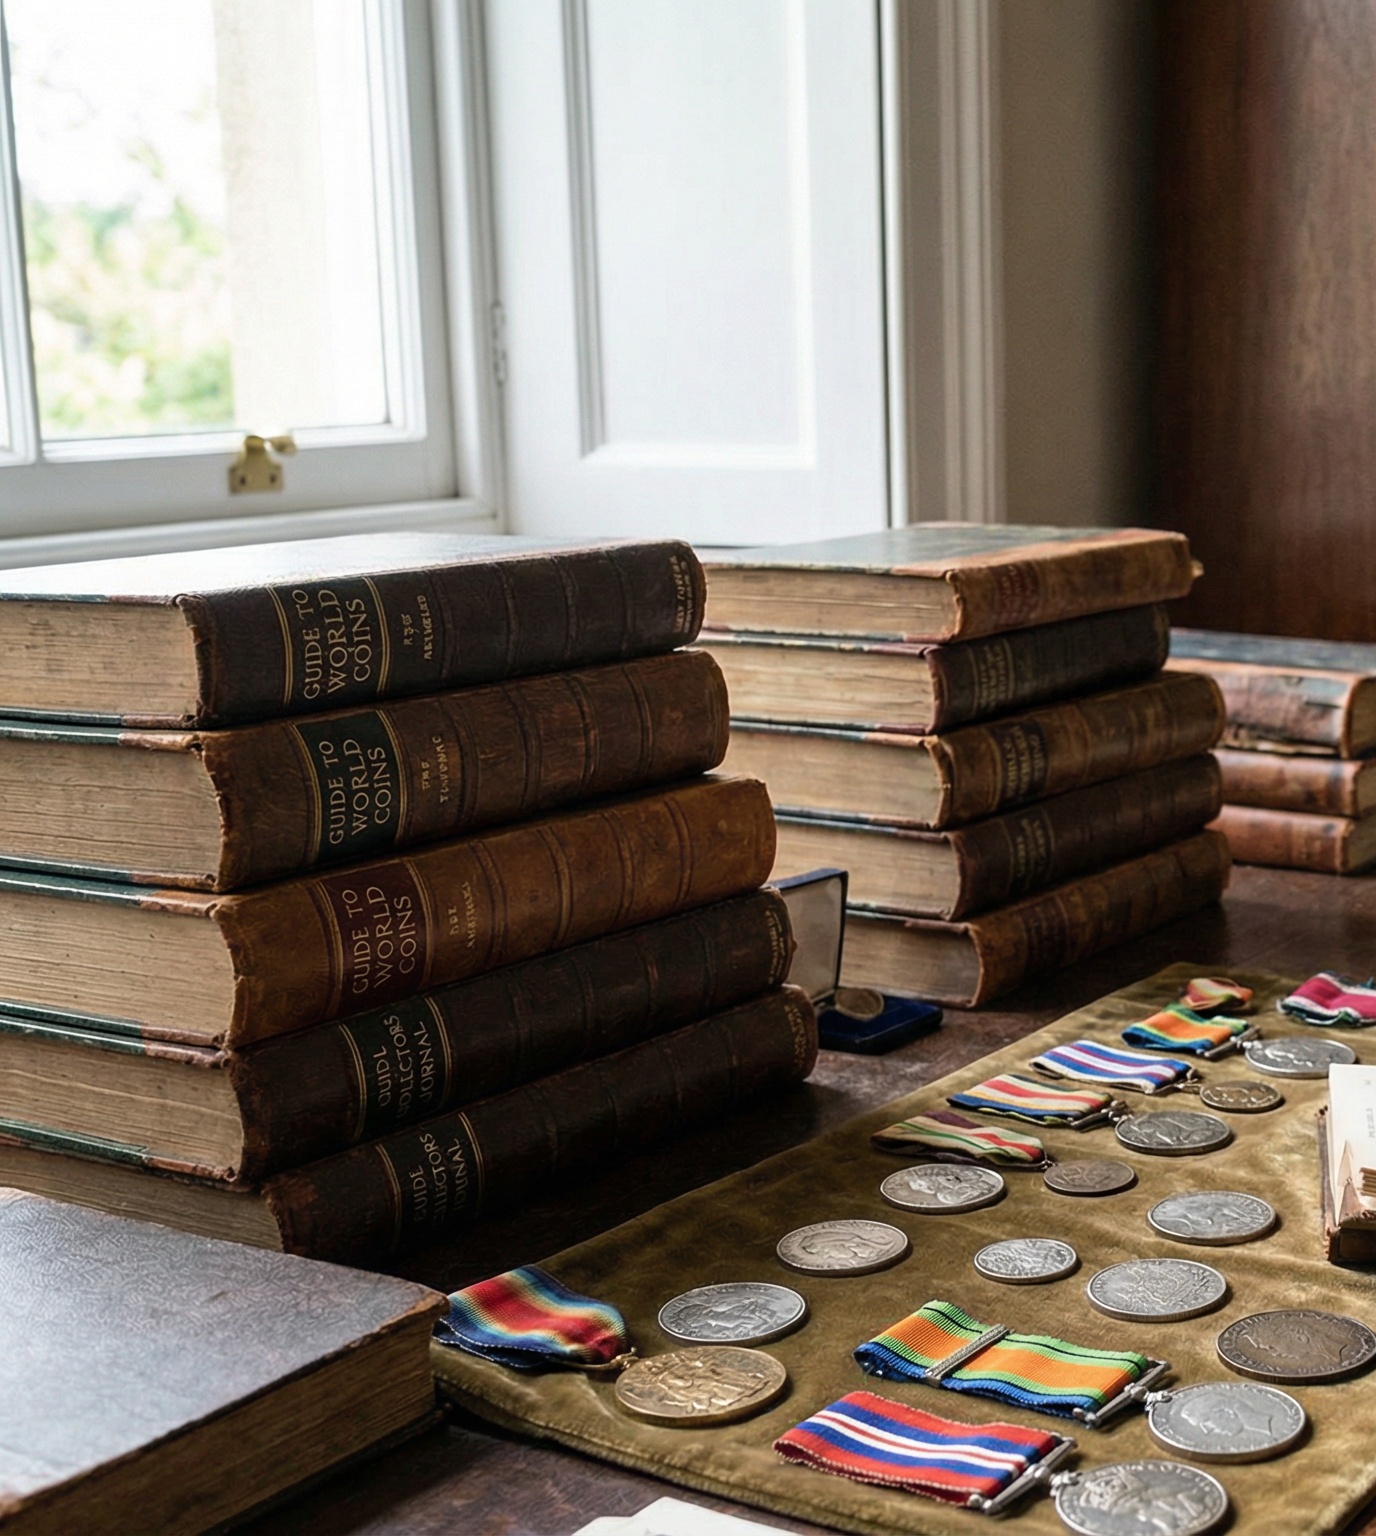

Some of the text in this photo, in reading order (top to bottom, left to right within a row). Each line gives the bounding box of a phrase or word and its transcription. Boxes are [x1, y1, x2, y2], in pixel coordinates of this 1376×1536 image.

[292, 589, 323, 700] GUIDE TO
[317, 589, 348, 694] WORLD
[346, 598, 372, 682] COINS
[318, 740, 347, 845] GUIDE TO
[343, 739, 370, 836] WORLD
[368, 747, 392, 825] COINS
[341, 889, 371, 994] GUIDE TO
[366, 886, 394, 989] WORLD
[394, 895, 417, 974] COINS
